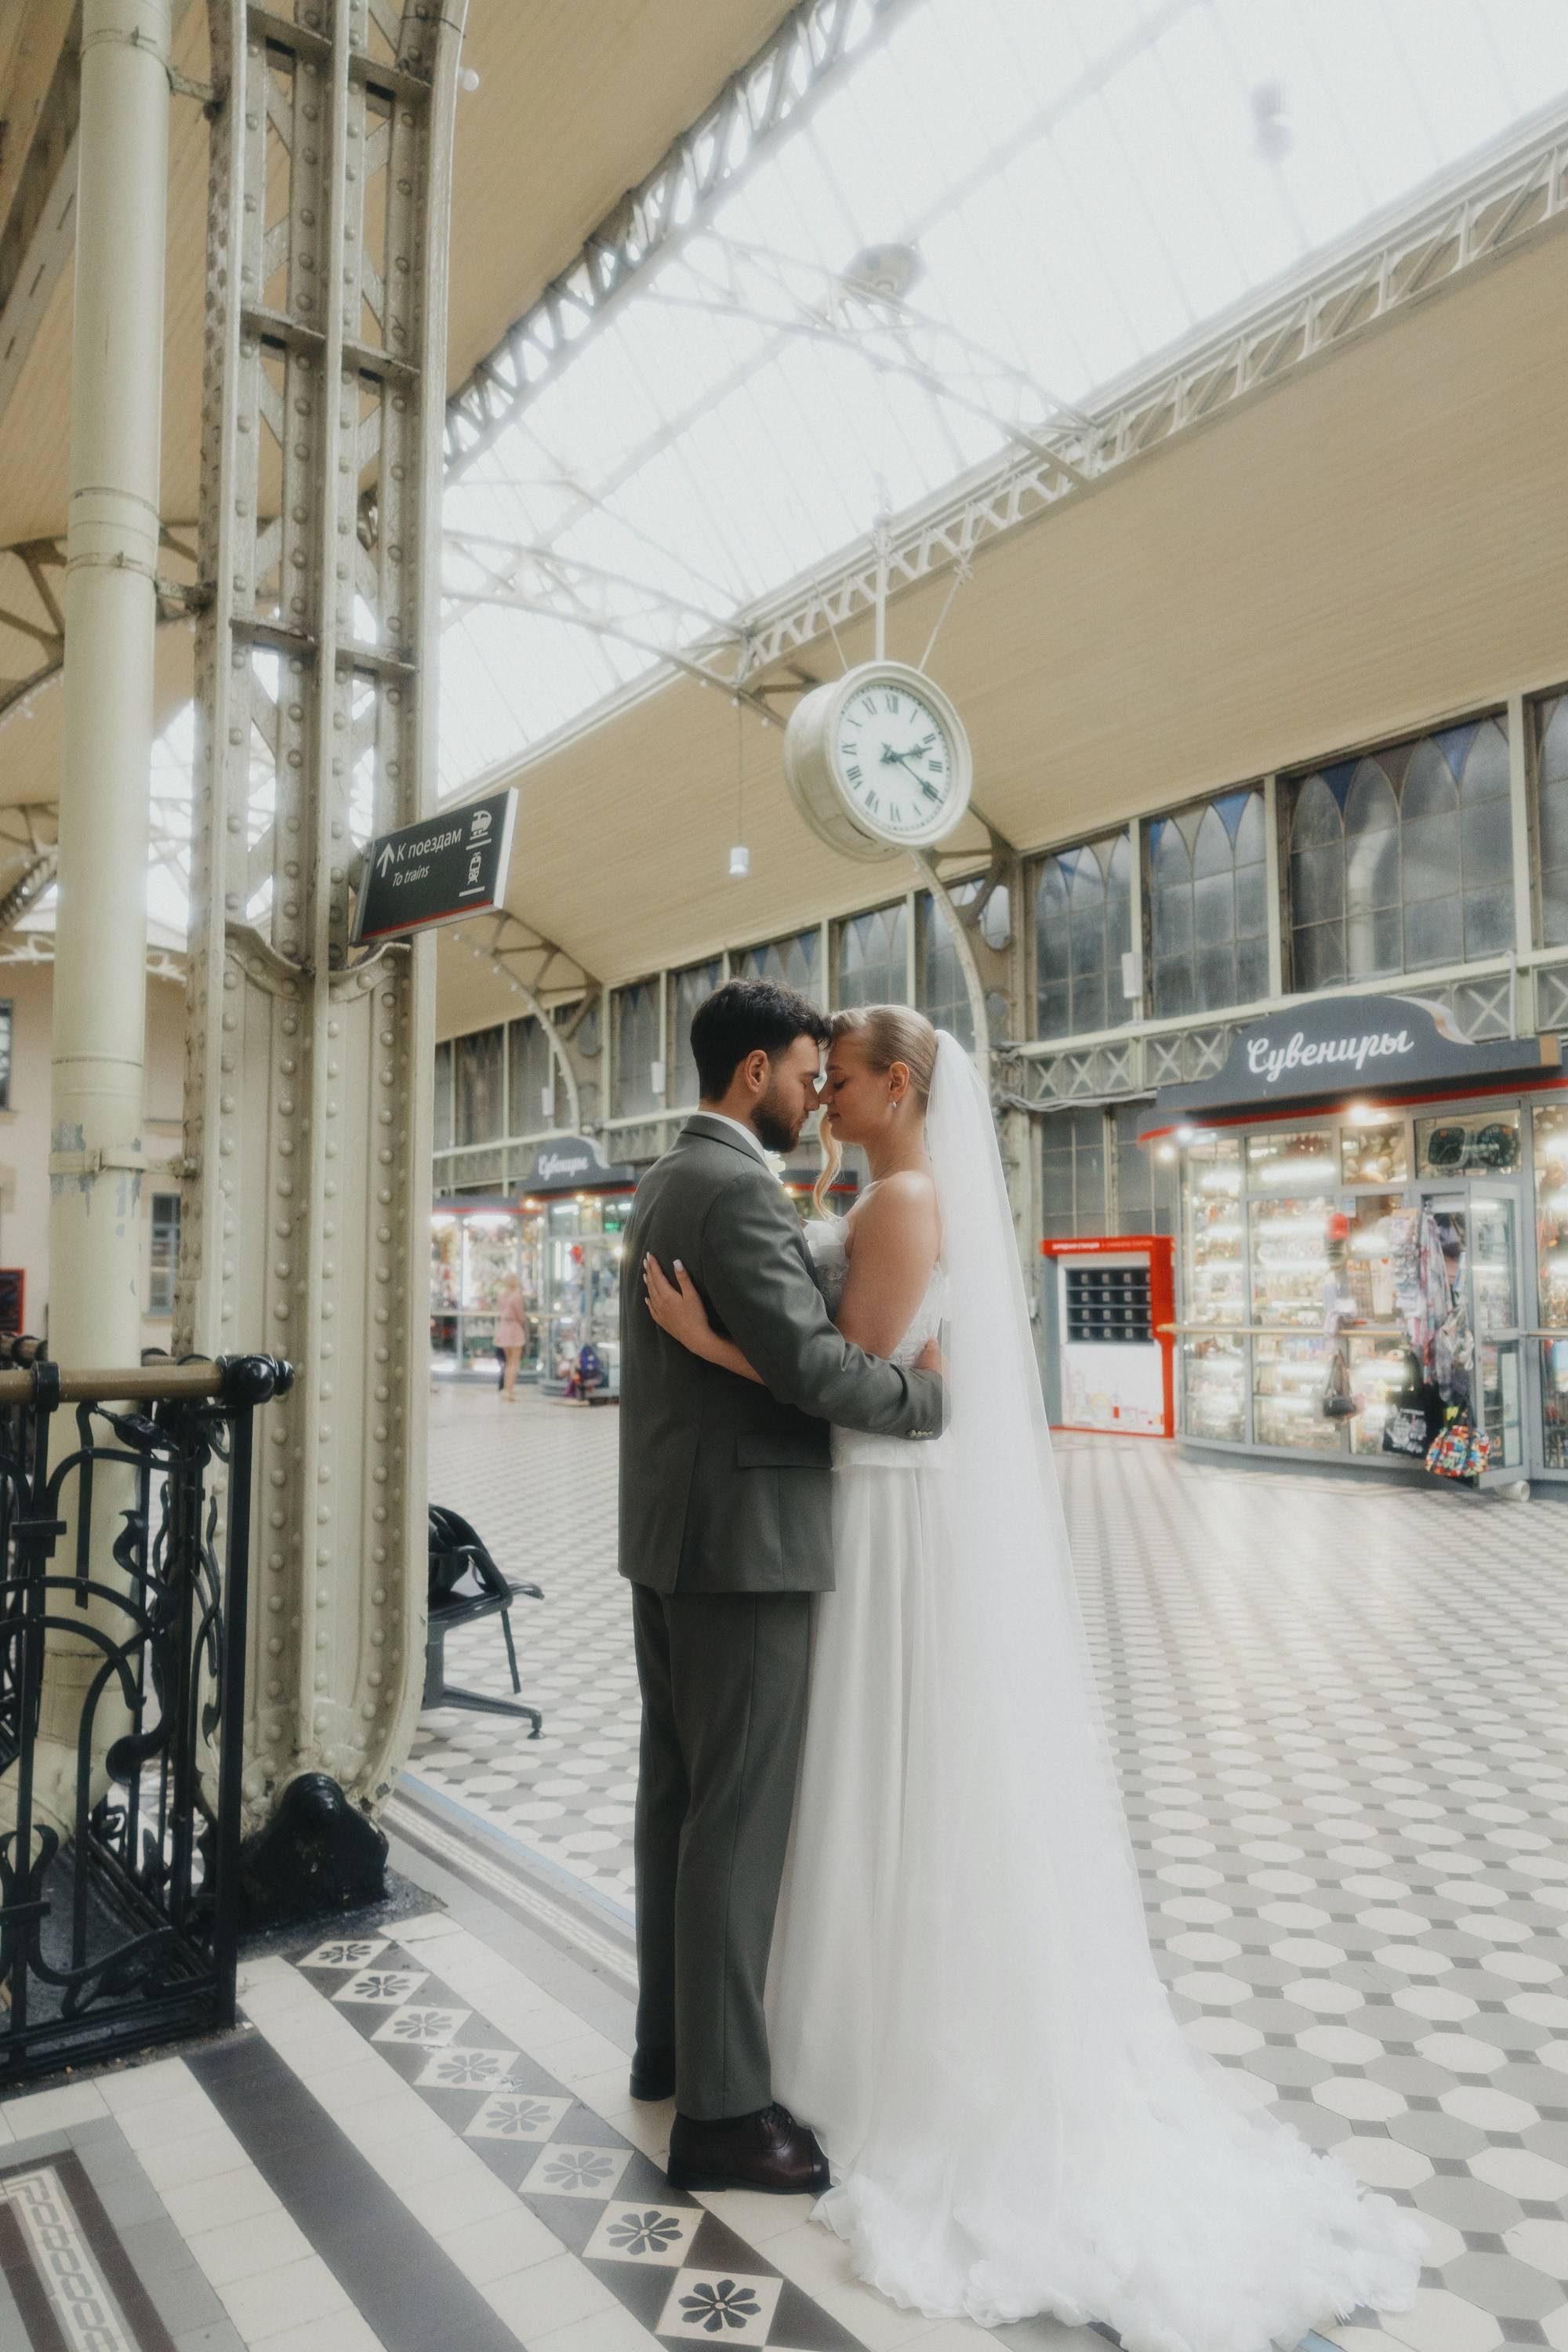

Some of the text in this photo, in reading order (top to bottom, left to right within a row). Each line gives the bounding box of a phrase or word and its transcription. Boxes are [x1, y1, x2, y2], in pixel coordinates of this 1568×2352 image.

[397, 828, 463, 863] К поездам
[393, 865, 430, 887] To trains
[1247, 1030, 1414, 1083] Сувениры
